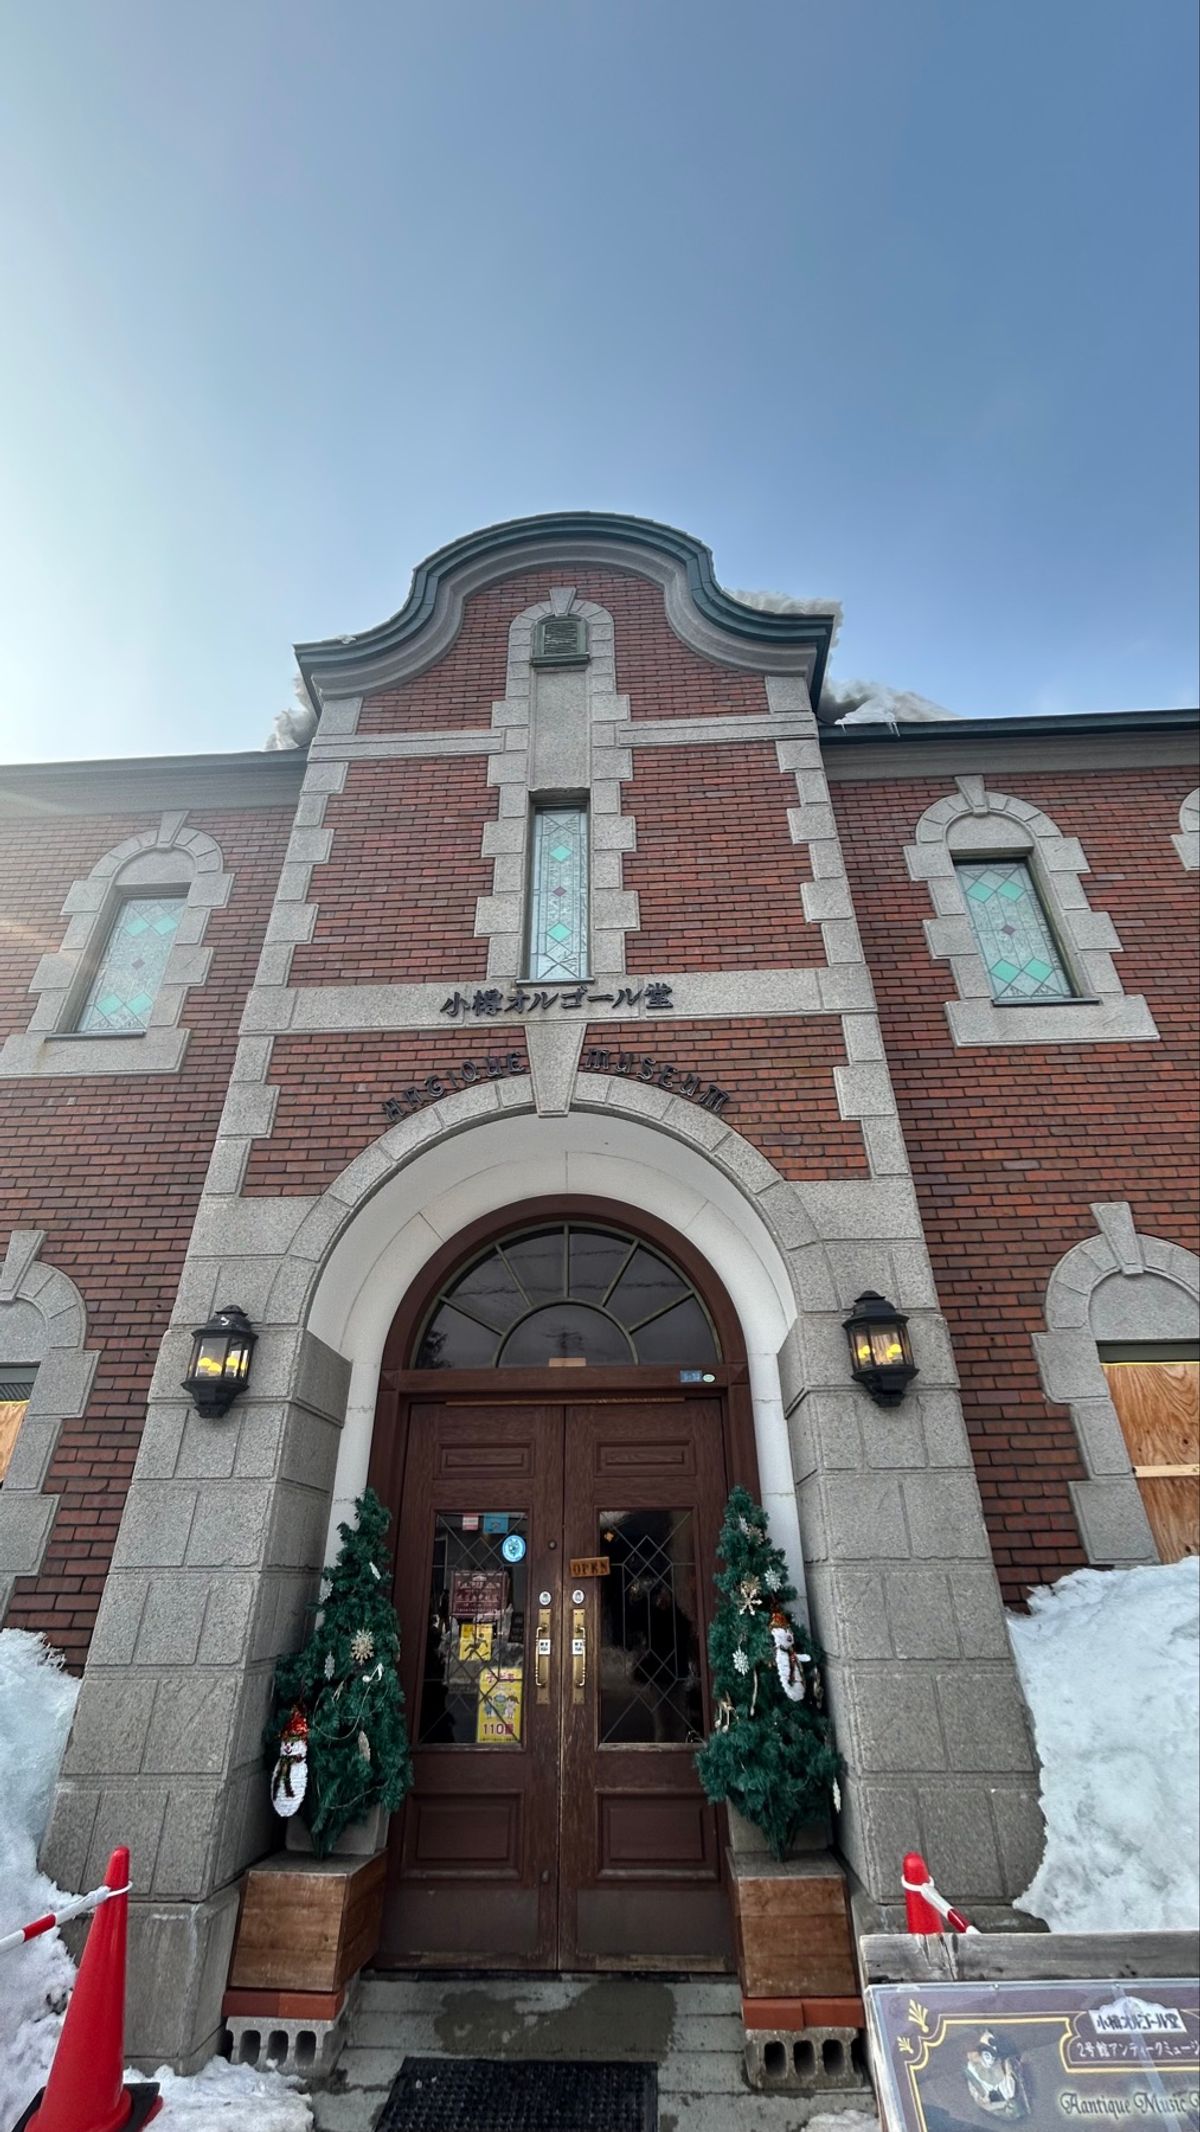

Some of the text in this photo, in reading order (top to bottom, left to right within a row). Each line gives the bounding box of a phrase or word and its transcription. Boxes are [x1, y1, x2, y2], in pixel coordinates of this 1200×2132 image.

[440, 982, 674, 1017] 小樽オルゴール堂
[382, 1048, 730, 1122] ANTIQUE MUSEUM
[572, 1560, 609, 1575] OPEN
[1133, 2092, 1187, 2114] Music
